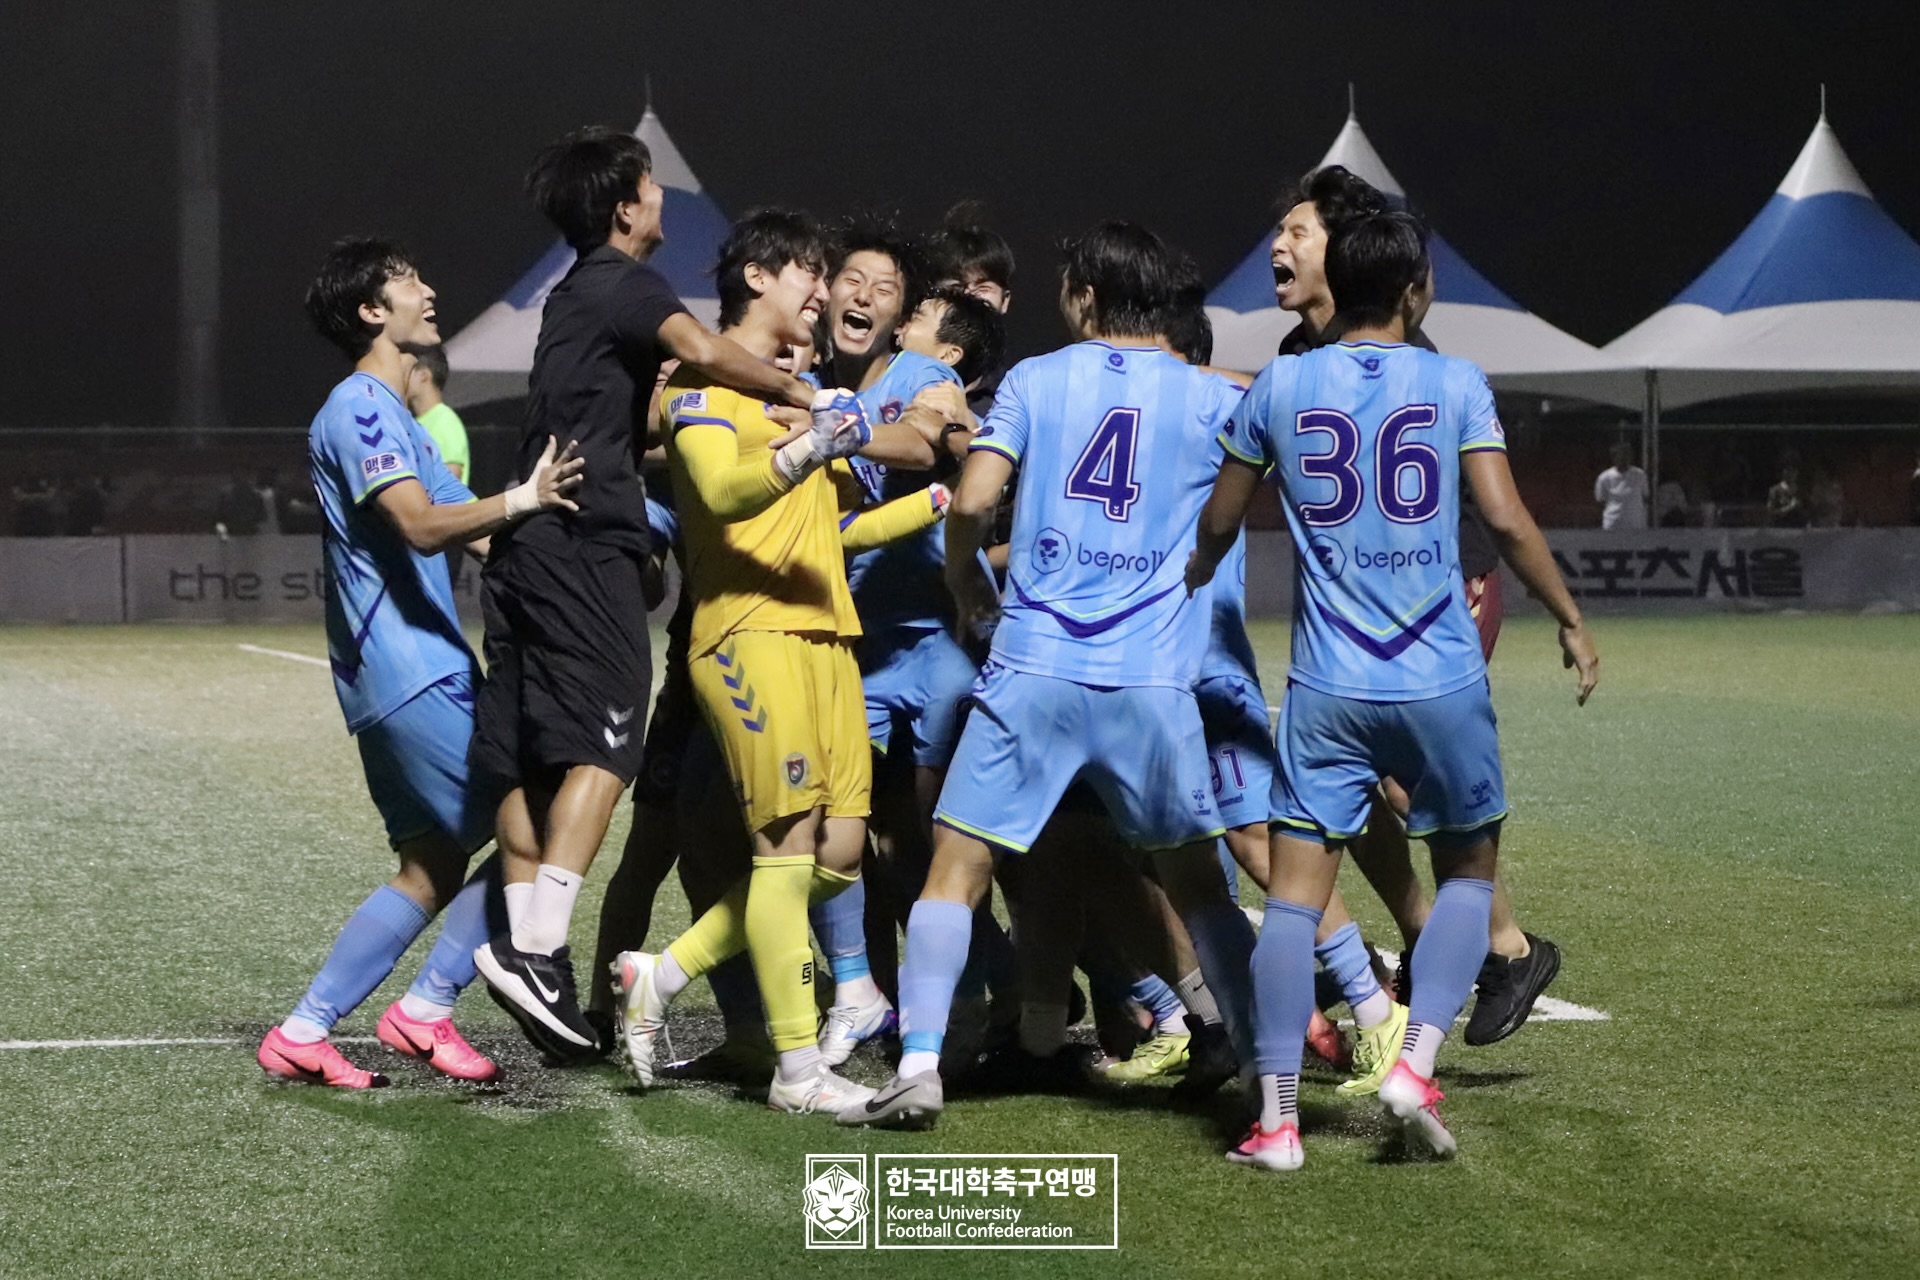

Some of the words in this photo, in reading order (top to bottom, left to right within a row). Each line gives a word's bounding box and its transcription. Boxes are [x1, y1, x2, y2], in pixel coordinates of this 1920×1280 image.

[1064, 406, 1142, 523] 4
[1294, 403, 1441, 528] 36
[169, 563, 260, 601] the
